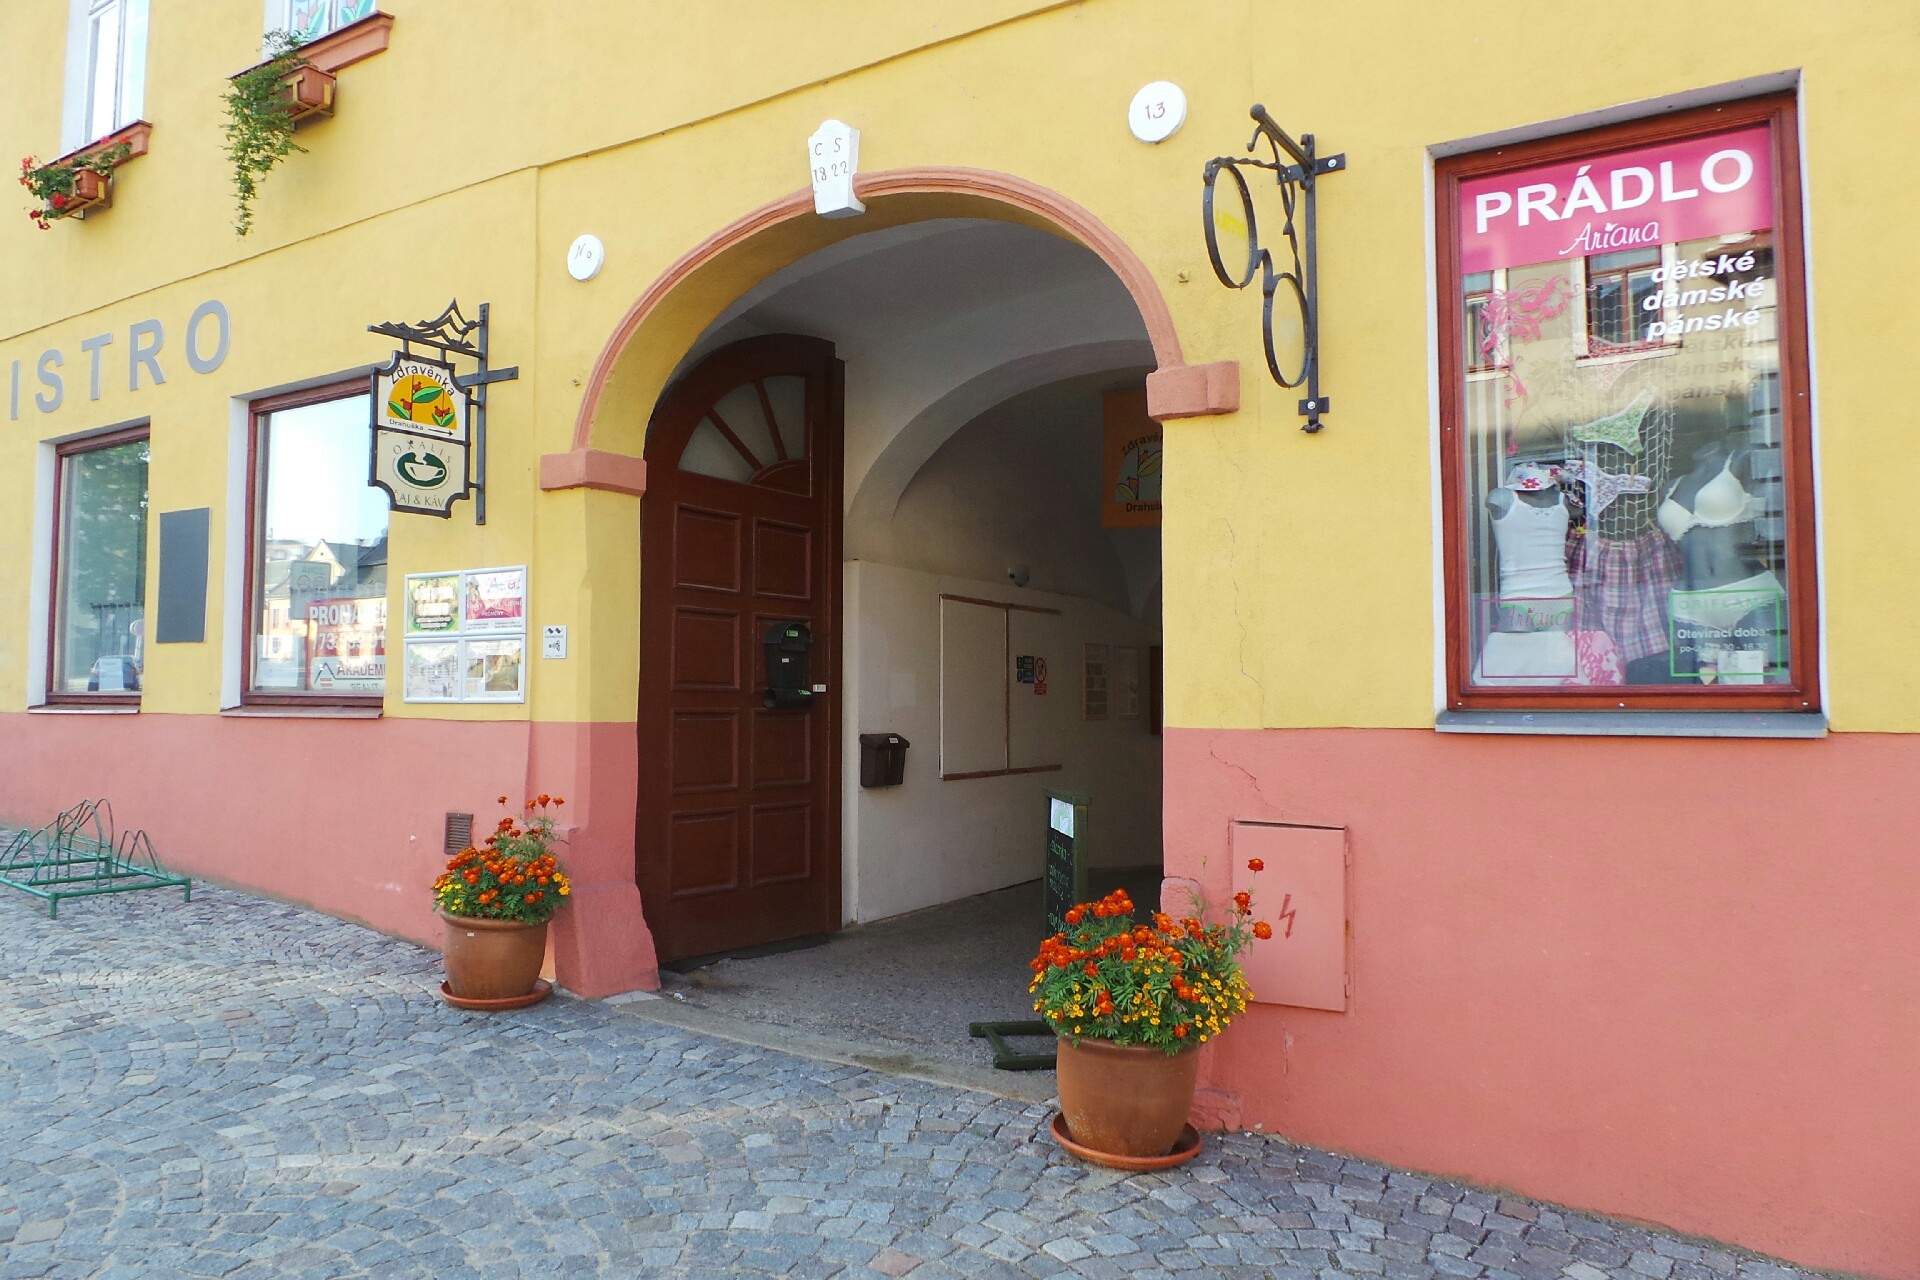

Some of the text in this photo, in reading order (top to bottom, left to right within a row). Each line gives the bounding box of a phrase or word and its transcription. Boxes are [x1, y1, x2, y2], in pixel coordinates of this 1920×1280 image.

[1145, 101, 1166, 121] 13
[814, 137, 842, 156] C S
[813, 160, 849, 184] 1822
[1475, 148, 1754, 235] PRÁDLO
[1559, 221, 1660, 255] Ariana
[1651, 250, 1756, 283] dětské
[1642, 276, 1766, 311] dámské
[1646, 305, 1761, 343] pánské
[10, 300, 232, 421] ISTRO
[391, 364, 455, 397] Zdravěnka
[413, 494, 421, 505] &
